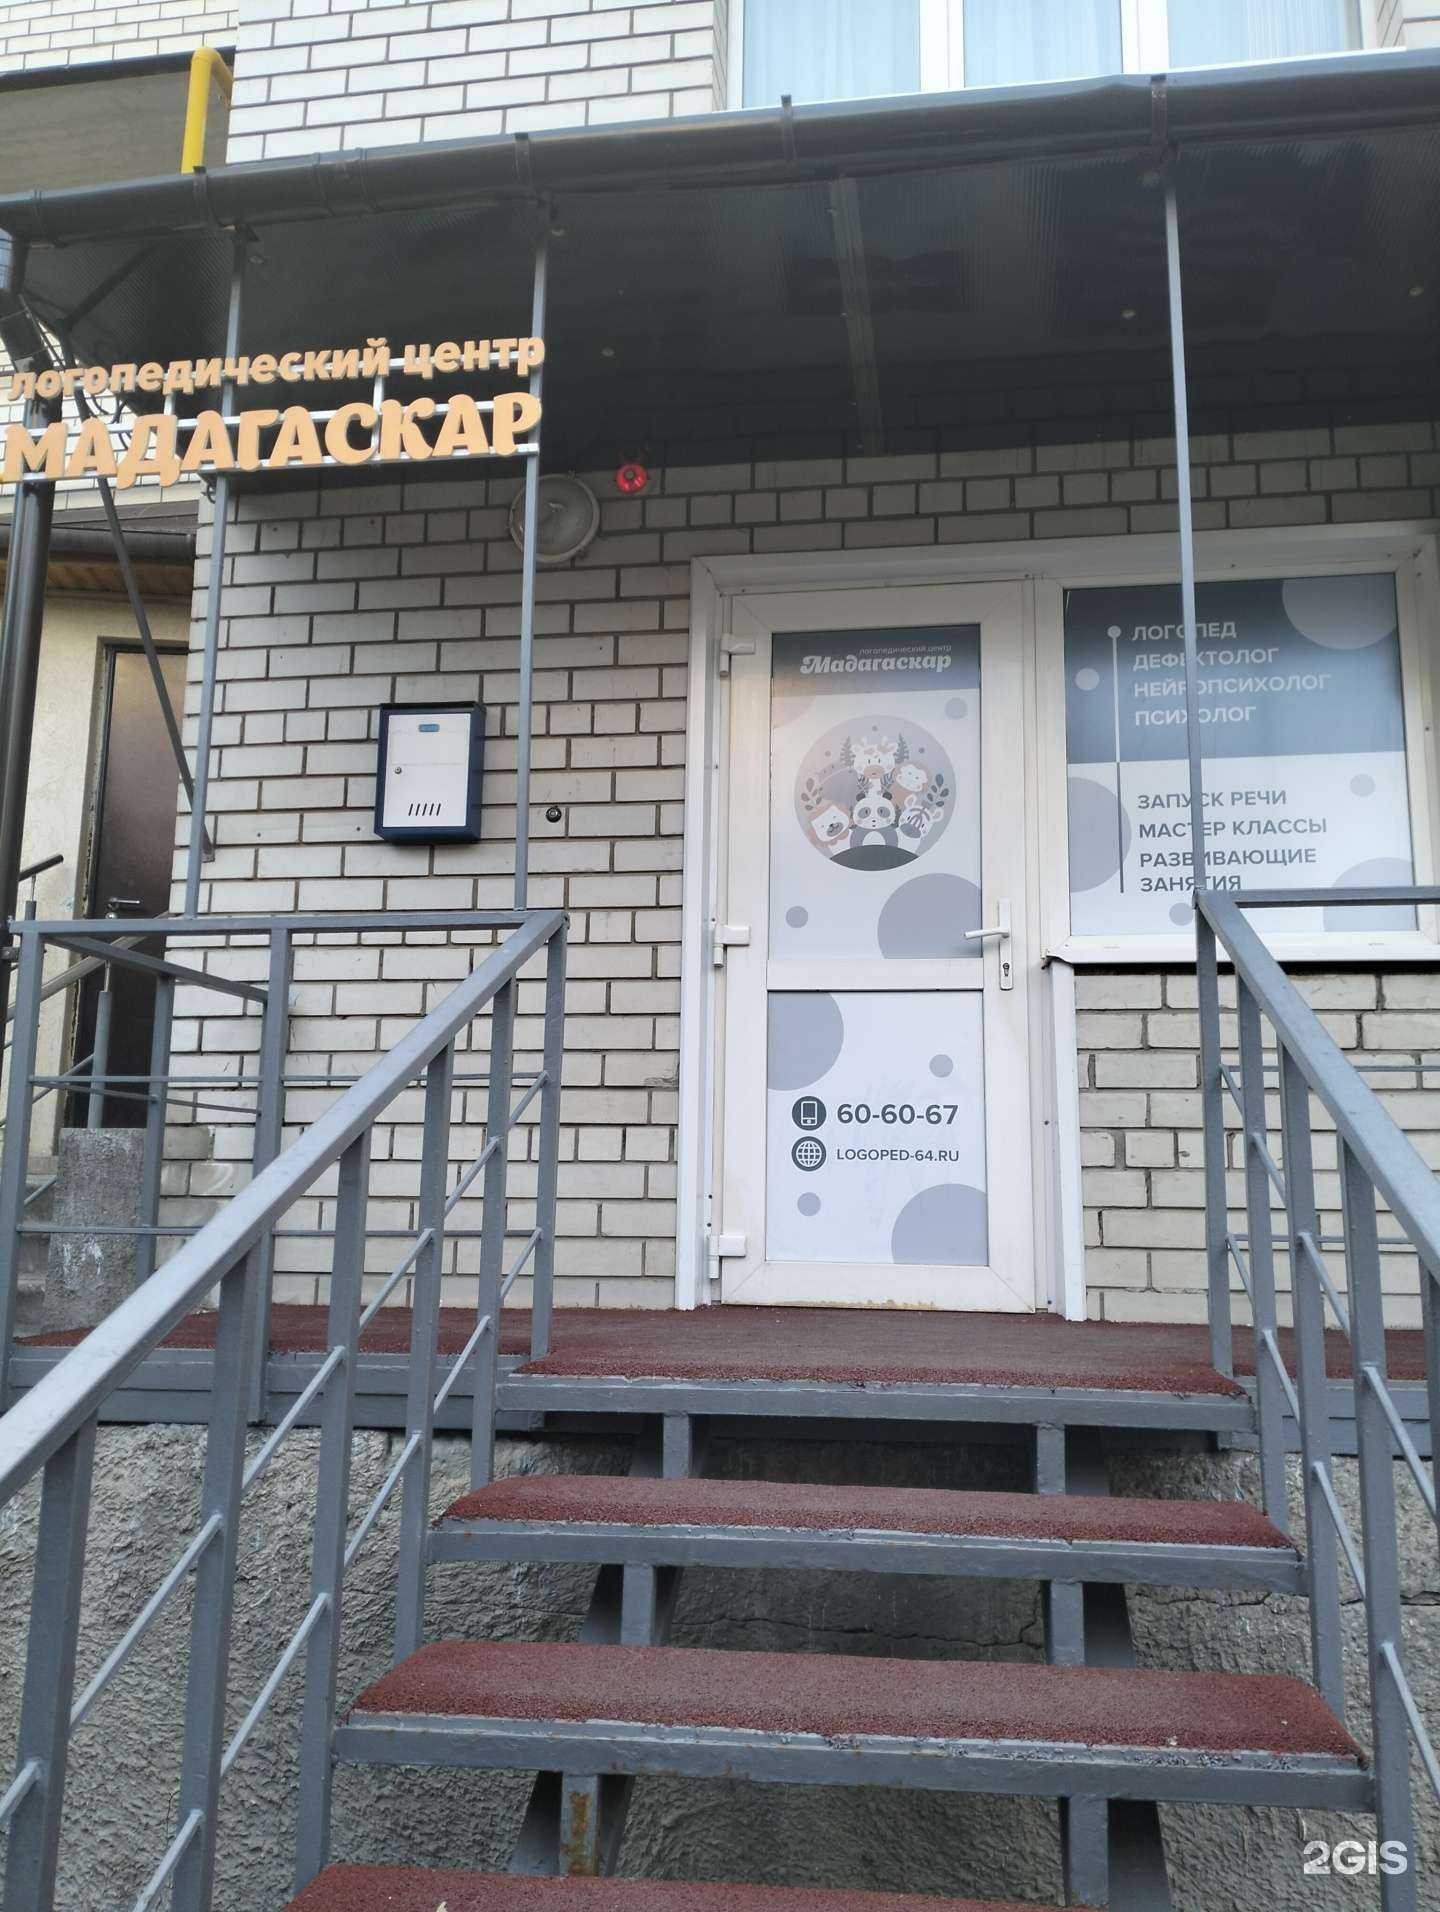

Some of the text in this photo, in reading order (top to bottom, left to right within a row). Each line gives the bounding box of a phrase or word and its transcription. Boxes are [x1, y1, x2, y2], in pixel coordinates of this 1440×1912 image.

[8, 336, 545, 400] логопедический центр
[1, 392, 543, 490] МАДАГАСКАР
[800, 655, 952, 674] Мадагаскар
[1231, 790, 1287, 806] РЕЧИ
[1233, 818, 1327, 835] КЛАССЫ
[837, 1103, 959, 1125] 60-60-67
[836, 1148, 960, 1162] LOGOPED-64.RU
